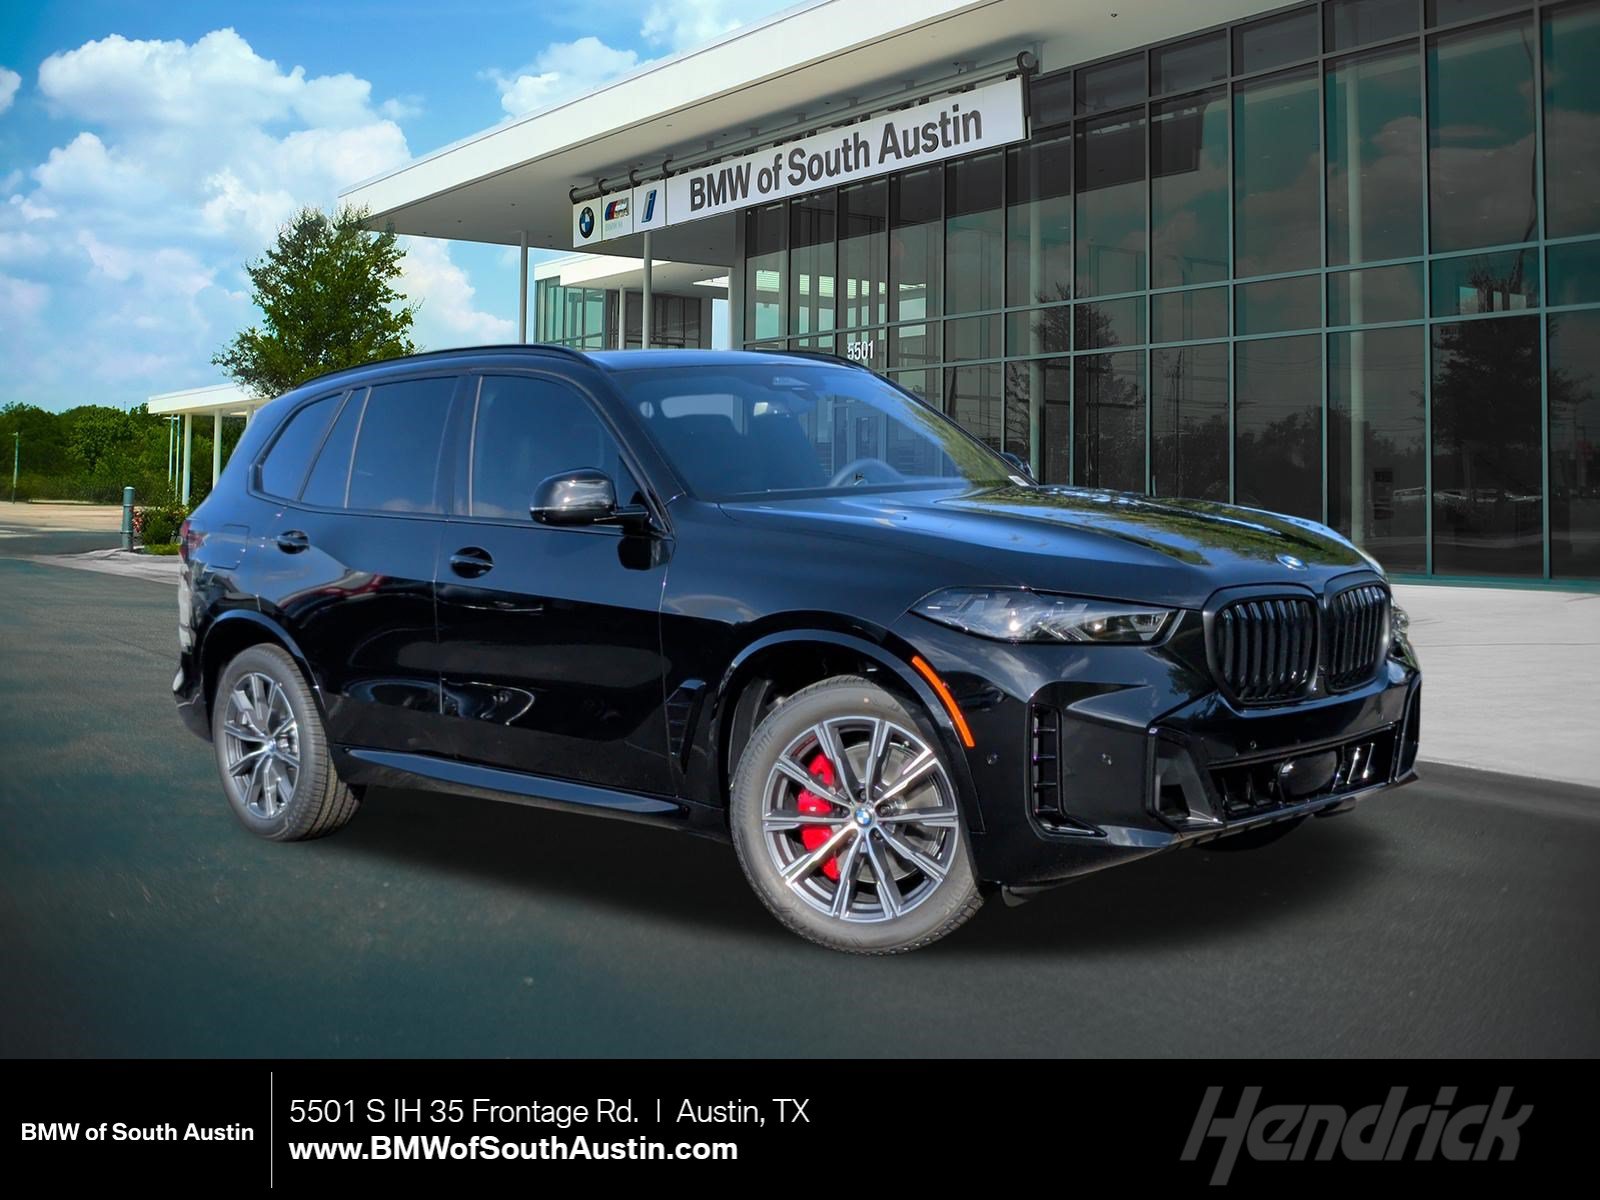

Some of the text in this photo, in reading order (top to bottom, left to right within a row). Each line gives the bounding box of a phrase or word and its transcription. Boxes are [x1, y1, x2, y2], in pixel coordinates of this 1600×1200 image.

[690, 103, 983, 212] BMW of South Austin
[847, 340, 874, 360] 5501
